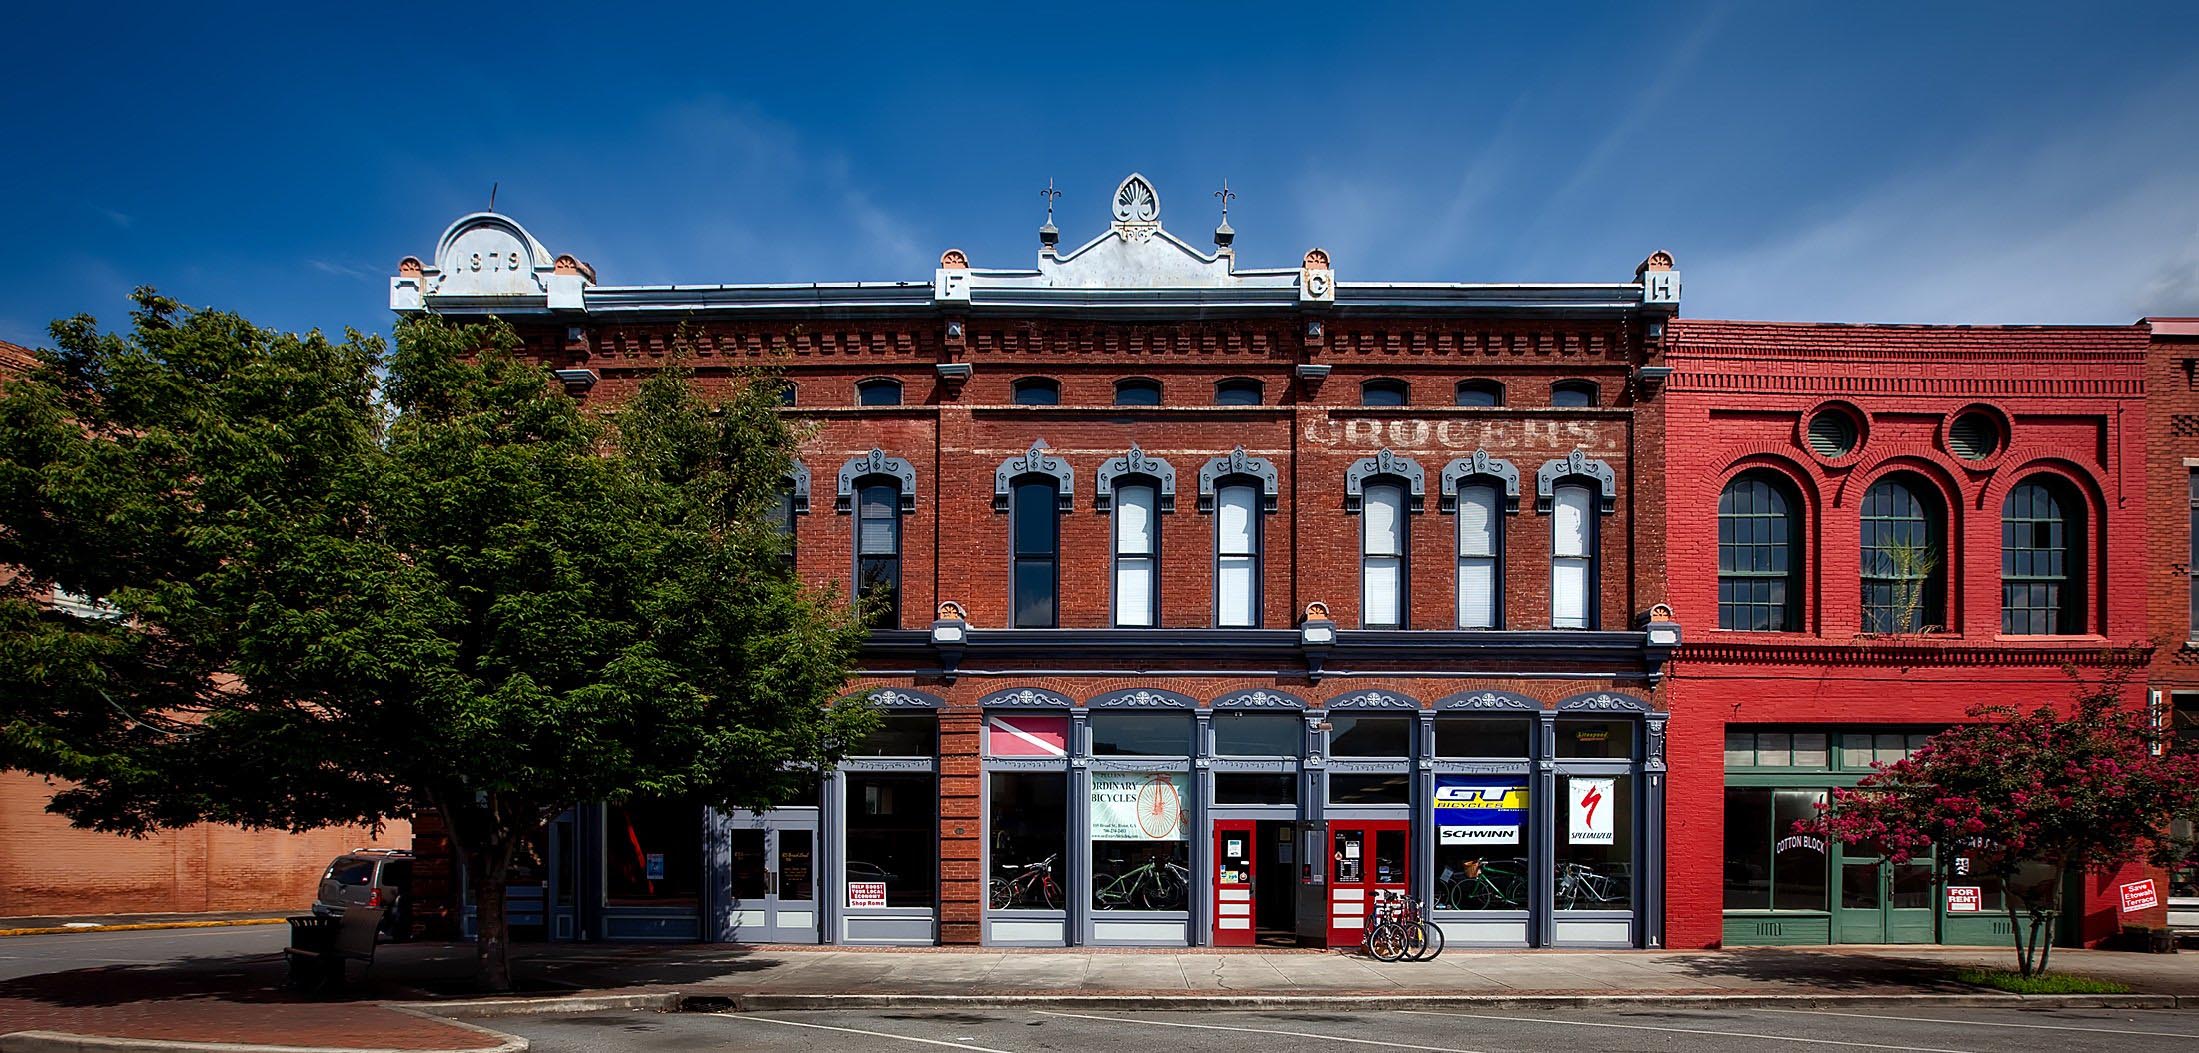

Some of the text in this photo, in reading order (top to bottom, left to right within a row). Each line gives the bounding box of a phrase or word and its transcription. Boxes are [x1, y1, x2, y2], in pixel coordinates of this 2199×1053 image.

[456, 252, 519, 274] 1879
[945, 273, 963, 297] F
[1652, 274, 1671, 300] H
[1092, 794, 1137, 803] BICYCLES
[1435, 786, 1514, 801] GT
[1442, 830, 1514, 838] SCHWINN
[1776, 835, 1825, 855] COTTON BLOCK
[1951, 888, 1974, 896] FOR
[2128, 884, 2147, 892] Save
[1948, 895, 1977, 903] RENT
[2125, 889, 2153, 900] Etowah
[2126, 897, 2154, 906] Terrace
